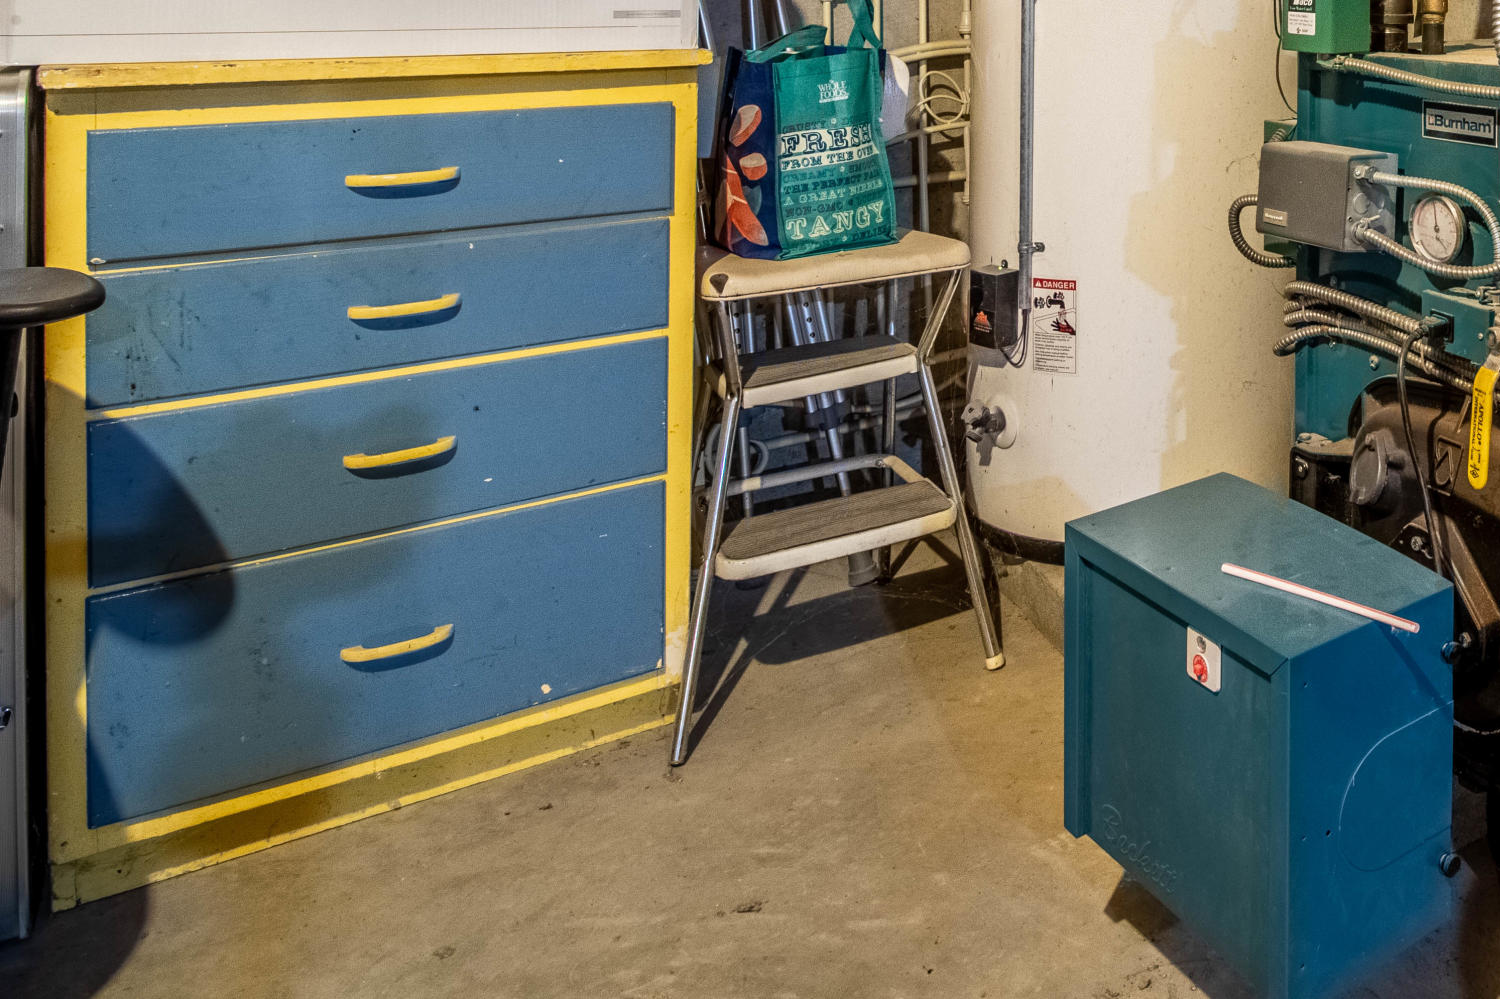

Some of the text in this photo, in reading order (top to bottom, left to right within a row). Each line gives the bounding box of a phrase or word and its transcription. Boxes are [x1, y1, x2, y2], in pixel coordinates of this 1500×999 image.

[817, 80, 848, 93] WHOLE
[820, 88, 848, 100] FOODS
[1434, 114, 1491, 134] Burnham
[781, 123, 873, 157] FRESH
[781, 156, 823, 170] FROM
[826, 151, 854, 164] THE
[783, 196, 794, 206] A
[799, 188, 846, 203] GREAT
[785, 200, 884, 240] TANGY
[1042, 280, 1075, 290] DANGER
[1477, 405, 1485, 441] APOLLO
